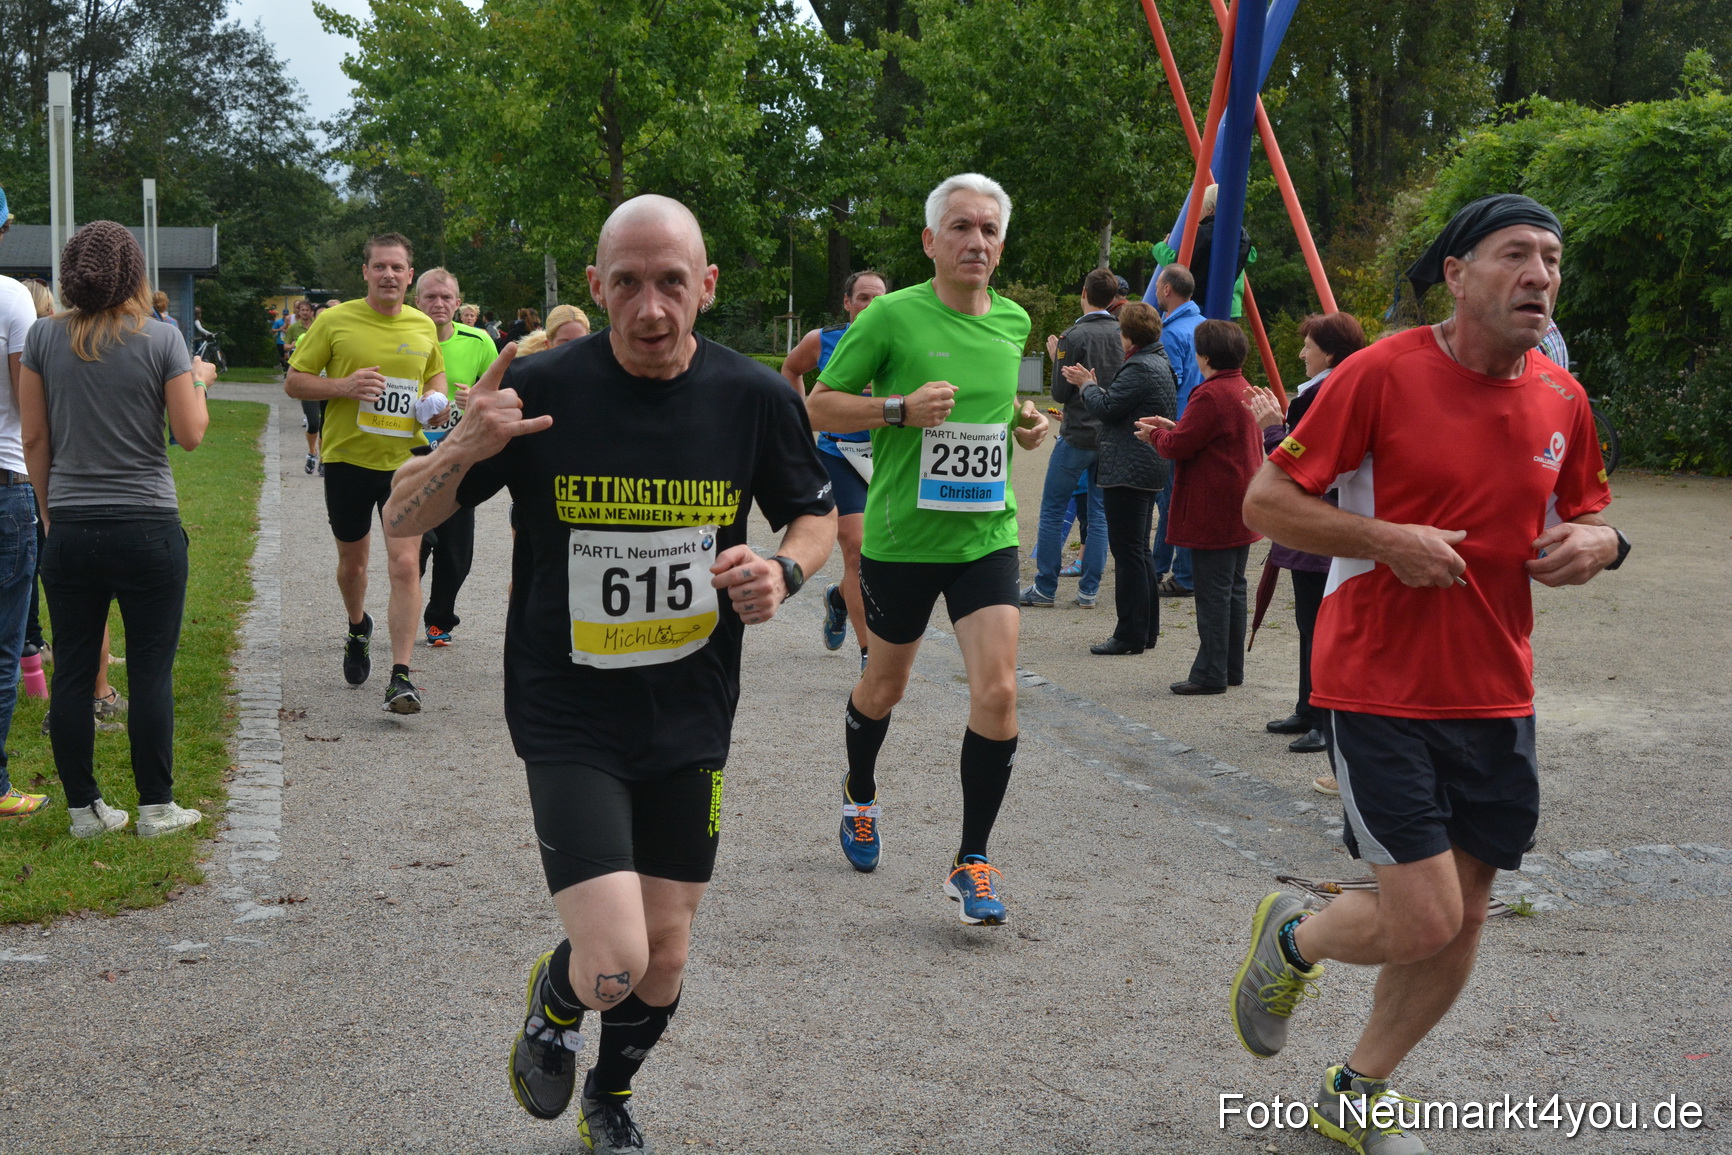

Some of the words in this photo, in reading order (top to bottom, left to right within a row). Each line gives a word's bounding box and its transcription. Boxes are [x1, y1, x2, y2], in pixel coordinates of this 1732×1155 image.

[386, 383, 414, 391] Neumarkt
[374, 391, 411, 414] 603
[925, 429, 957, 439] PARTL
[960, 432, 998, 441] Neumarkt
[931, 443, 1002, 478] 2339
[940, 485, 992, 499] Christian
[559, 506, 600, 519] TEAM
[605, 508, 672, 522] MEMBER
[573, 543, 623, 559] PARTL
[628, 542, 696, 559] Neumarkt
[602, 562, 693, 617] 615
